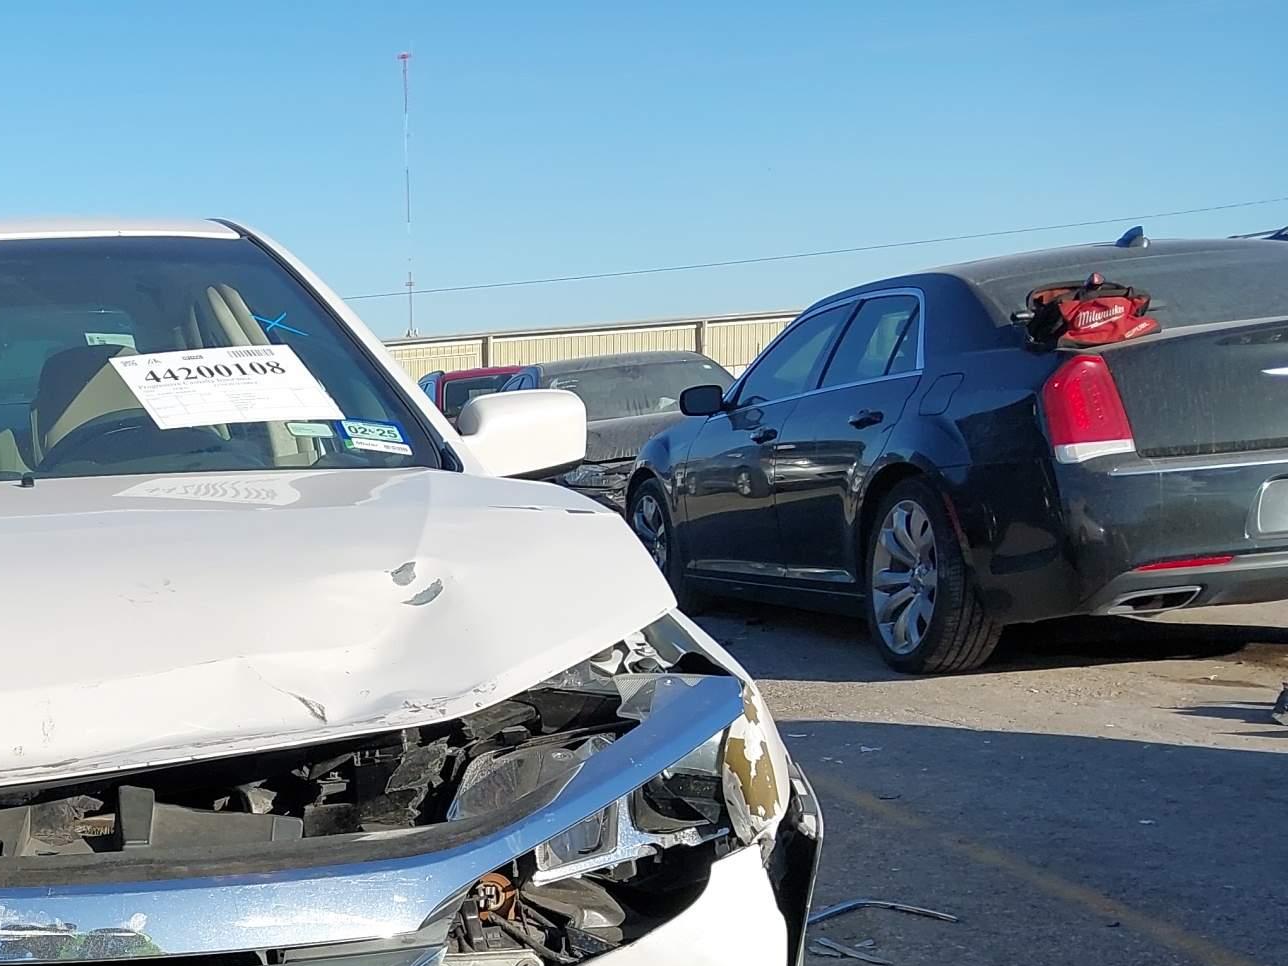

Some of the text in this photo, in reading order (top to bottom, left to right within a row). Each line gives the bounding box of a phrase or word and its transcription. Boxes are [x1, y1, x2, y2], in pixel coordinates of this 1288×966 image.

[144, 360, 287, 383] 44200108
[347, 425, 399, 439] 02 25
